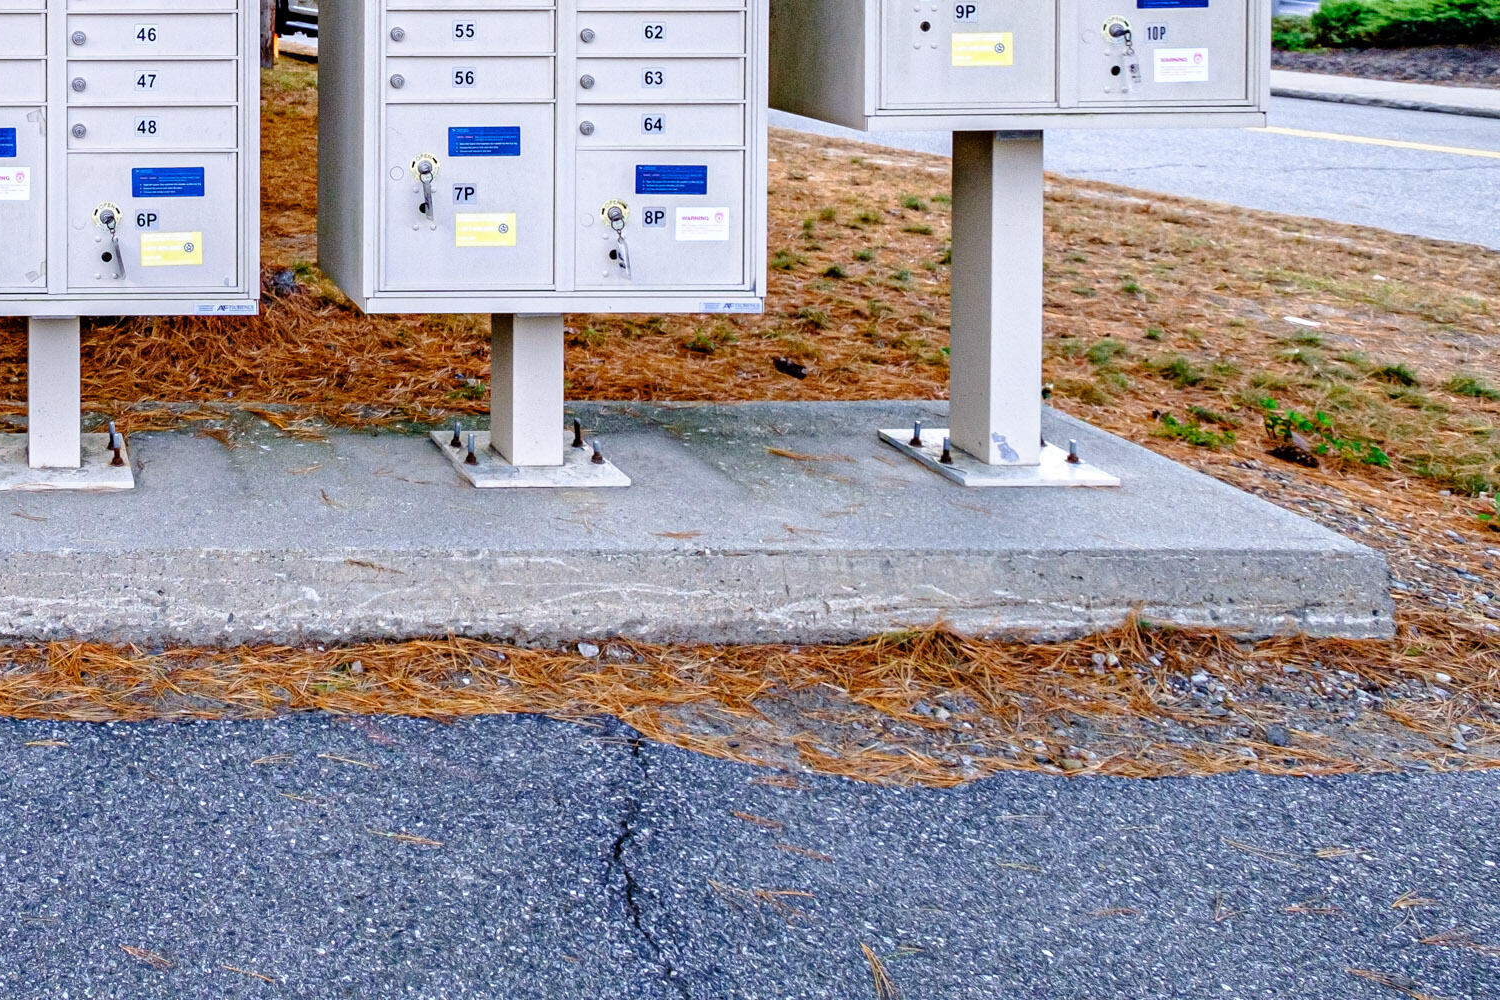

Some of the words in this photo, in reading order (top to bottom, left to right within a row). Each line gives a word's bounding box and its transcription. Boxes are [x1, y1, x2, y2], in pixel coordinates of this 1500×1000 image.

[955, 4, 976, 19] 9P
[136, 27, 157, 42] 46
[455, 23, 475, 39] 55
[644, 24, 663, 40] 62
[1147, 25, 1166, 41] 10P
[136, 73, 157, 88] 47
[454, 70, 475, 85] 56
[644, 70, 664, 86] 63
[136, 119, 157, 135] 48
[643, 117, 663, 132] 64
[454, 186, 475, 201] 7P
[136, 212, 158, 228] 6P
[644, 210, 665, 225] 8P
